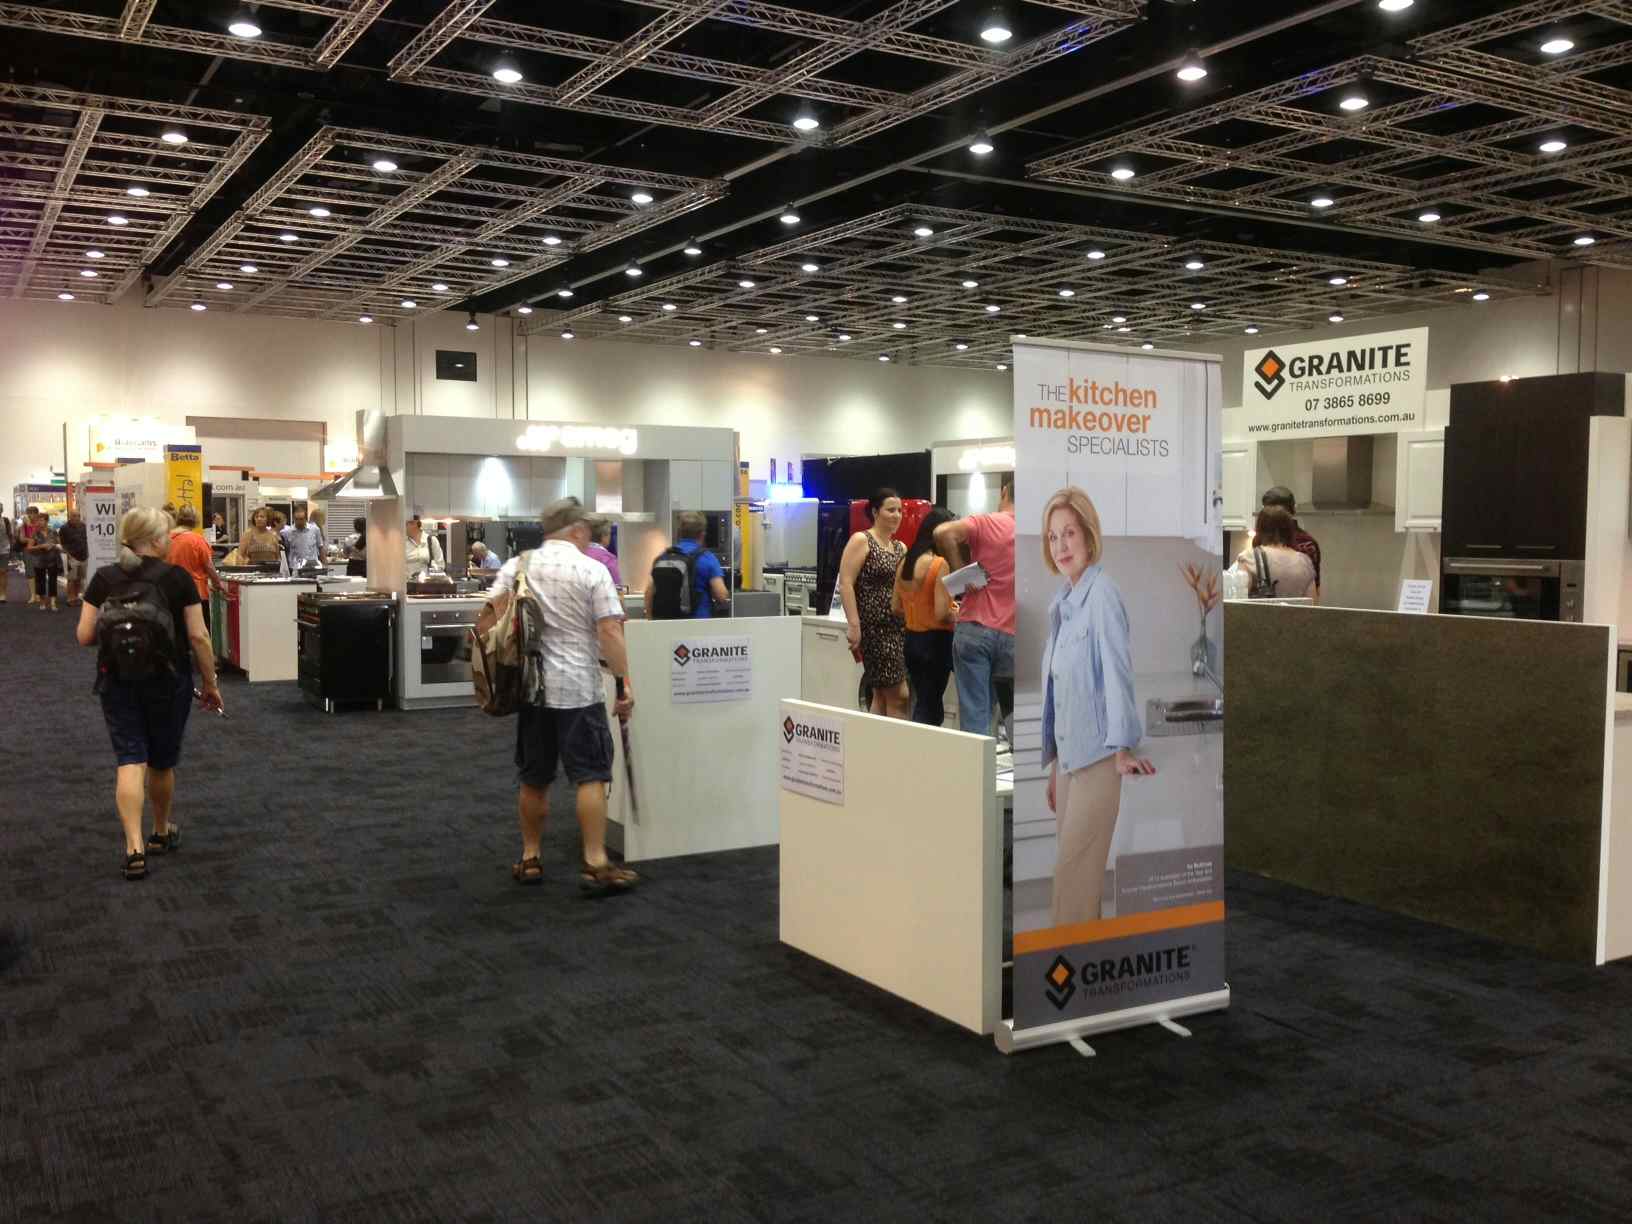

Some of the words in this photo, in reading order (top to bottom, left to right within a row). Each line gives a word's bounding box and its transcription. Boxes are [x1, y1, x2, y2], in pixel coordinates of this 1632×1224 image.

[1288, 343, 1411, 379] GRANITE
[1289, 370, 1410, 393] TRANSFORMATIONS
[1038, 384, 1067, 402] THE
[1068, 377, 1157, 409] kitchen
[1305, 398, 1319, 411] 07
[1324, 395, 1354, 410] 3865
[1358, 392, 1391, 406] 8699
[1029, 404, 1151, 434] makeover
[1248, 411, 1415, 433] www.granitetransformations.com.au
[1067, 435, 1169, 457] SPECIALISTS
[170, 453, 199, 462] Betta
[692, 645, 748, 658] GRANITE
[795, 723, 841, 745] GRANITE
[1080, 945, 1191, 986] GRANITE
[1083, 969, 1191, 1000] TRANSFORMATIONS
